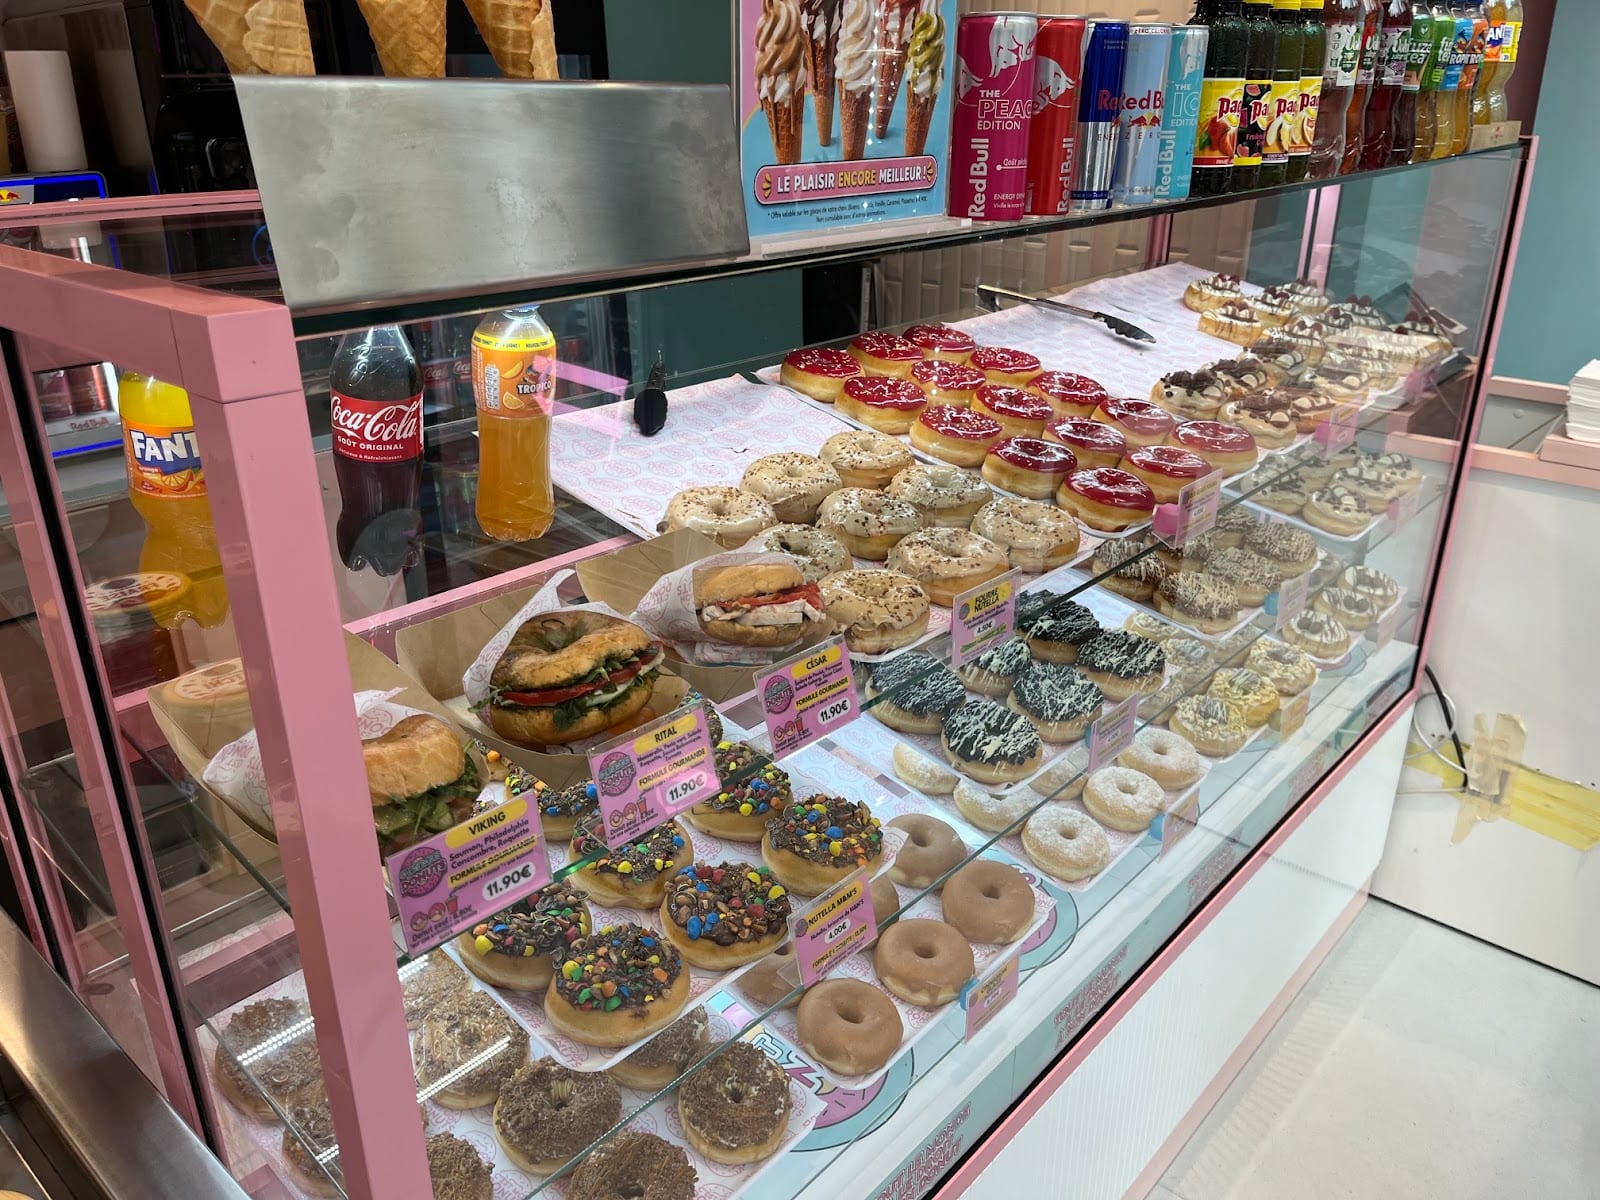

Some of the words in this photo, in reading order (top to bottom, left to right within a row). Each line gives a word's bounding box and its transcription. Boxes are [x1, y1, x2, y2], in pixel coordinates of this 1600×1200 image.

[980, 90, 1000, 98] THE
[978, 120, 1020, 130] EDITION
[970, 138, 990, 176] Bull
[1061, 138, 1074, 174] Bull
[1160, 130, 1176, 161] Bull
[777, 176, 790, 192] LE
[794, 173, 835, 191] PLAISIR
[838, 170, 876, 187] ENCORE
[879, 166, 921, 184] MEILLEUR
[1155, 162, 1172, 196] Red
[968, 178, 987, 217] Red
[1056, 176, 1072, 212] Red
[517, 381, 552, 394] TROPICO
[331, 396, 417, 441] Coca-Cola
[338, 435, 357, 448] GOÛT
[360, 443, 404, 451] ORIGINAL
[806, 654, 827, 670] CÉSAR
[796, 690, 818, 707] FORMULE
[818, 677, 848, 696] GOURMANDE
[820, 700, 848, 722] 11.90€
[654, 726, 677, 743] RITAL
[600, 766, 635, 791] DONUTS
[639, 766, 667, 786] FORMULE
[668, 748, 705, 772] GOURMANDE
[668, 774, 704, 802] 11.90€
[468, 811, 506, 836] VIKING
[449, 842, 482, 862] Saumon,
[484, 818, 529, 845] Philadelphia
[451, 844, 497, 870] Concombre,
[497, 828, 530, 848] Roquette
[401, 859, 448, 892] DONUTS
[450, 860, 486, 884] FORMULE
[486, 864, 532, 897] 11.90€
[808, 903, 836, 926] NUTELLA
